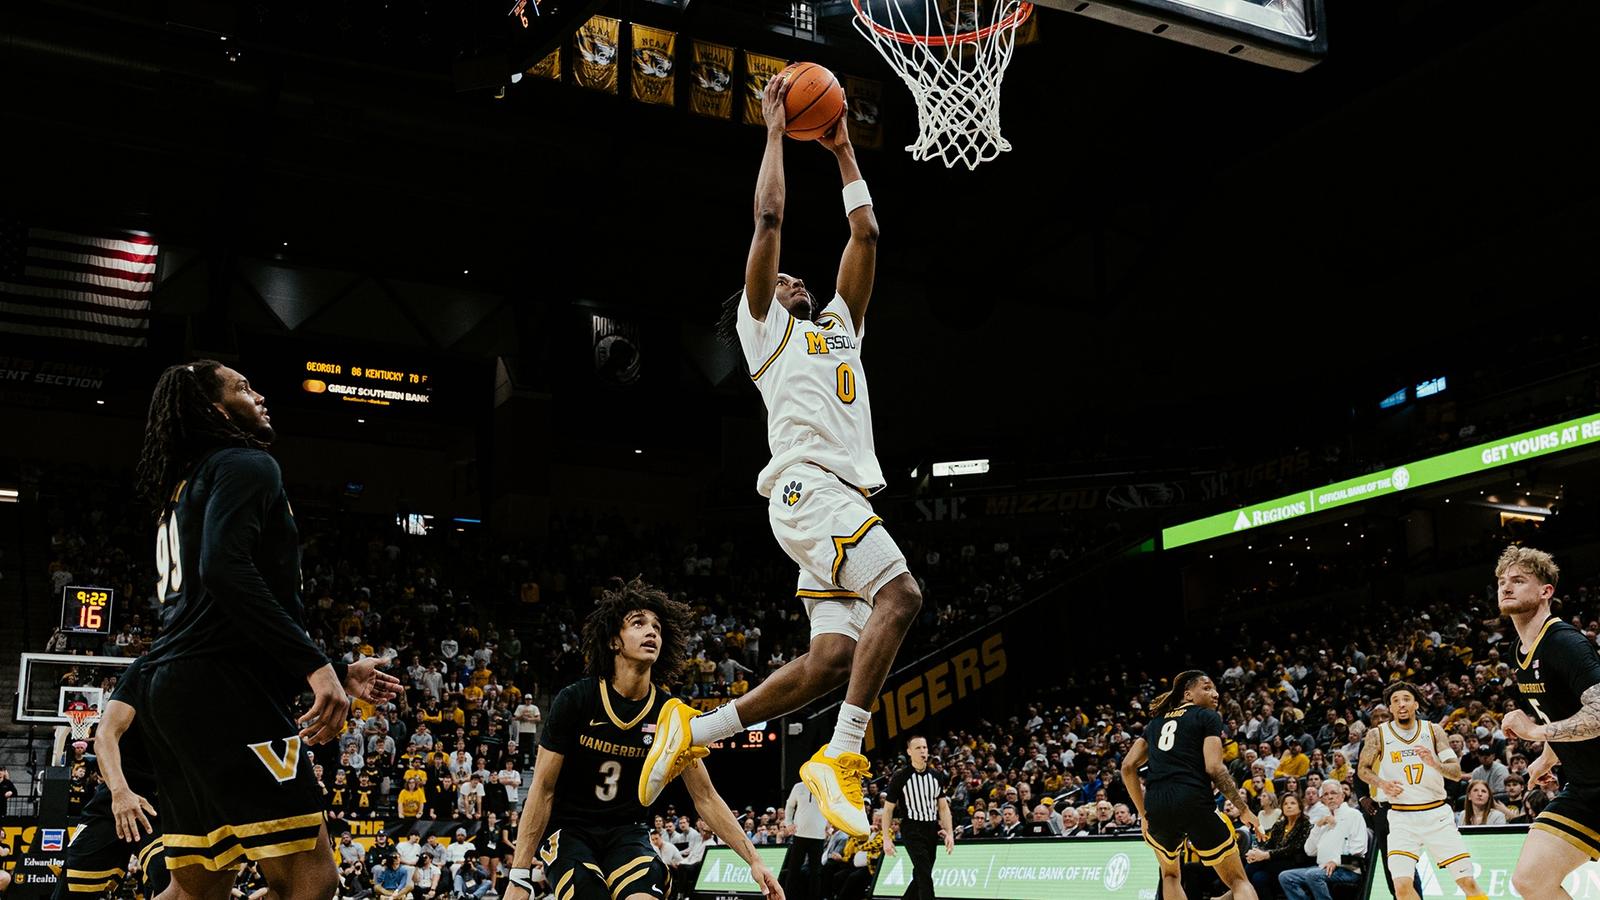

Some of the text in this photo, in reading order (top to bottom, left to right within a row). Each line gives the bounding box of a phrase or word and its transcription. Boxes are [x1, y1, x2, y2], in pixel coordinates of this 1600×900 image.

[641, 37, 668, 50] NCAA
[33, 373, 104, 390] SECTION
[306, 361, 341, 374] GEORGIA
[365, 368, 404, 382] KENTUCKY
[327, 383, 430, 403] GREAT SOUTHERN BANK
[836, 362, 857, 405] 0
[1482, 444, 1510, 464] GET
[1510, 431, 1560, 456] YOURS
[1561, 425, 1580, 444] AT
[984, 488, 1102, 517] MIZZOU
[1252, 501, 1306, 527] REGIONS
[77, 591, 108, 606] 9:22
[80, 605, 102, 629] 16
[580, 734, 650, 758] VANDERBIL
[748, 731, 764, 744] 60
[1157, 720, 1178, 752] 8
[246, 735, 301, 783] V
[594, 760, 622, 802] 3
[1403, 763, 1424, 785] 17
[350, 820, 385, 835] THE
[27, 874, 58, 883] Health
[998, 865, 1103, 881] OFFICIAL BANK OF THE
